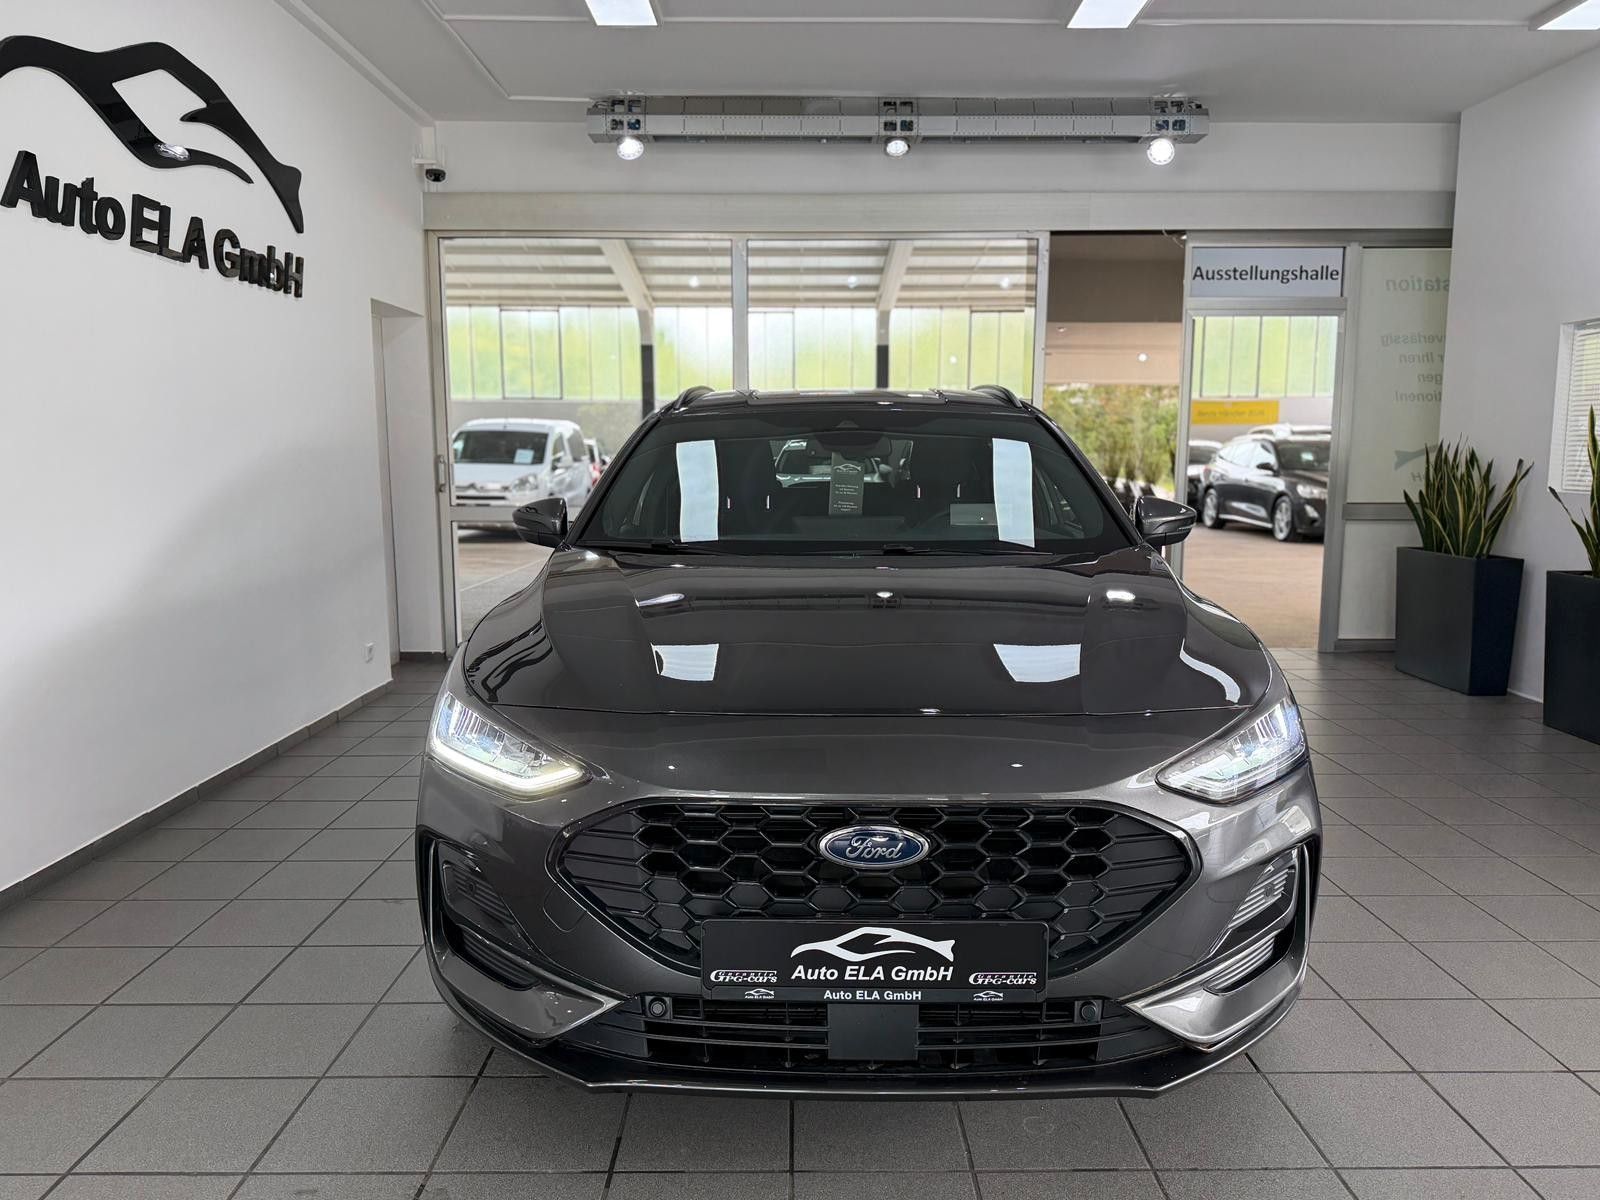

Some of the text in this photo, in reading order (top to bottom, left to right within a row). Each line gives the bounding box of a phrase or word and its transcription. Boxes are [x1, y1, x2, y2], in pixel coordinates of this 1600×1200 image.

[0, 150, 304, 298] Auto ELA GmbH
[1192, 265, 1340, 285] Ausstellungshalle
[846, 835, 904, 859] Ford
[790, 965, 954, 981] Auto ELA GmbH
[824, 990, 922, 1000] Auto ELA GmbH
